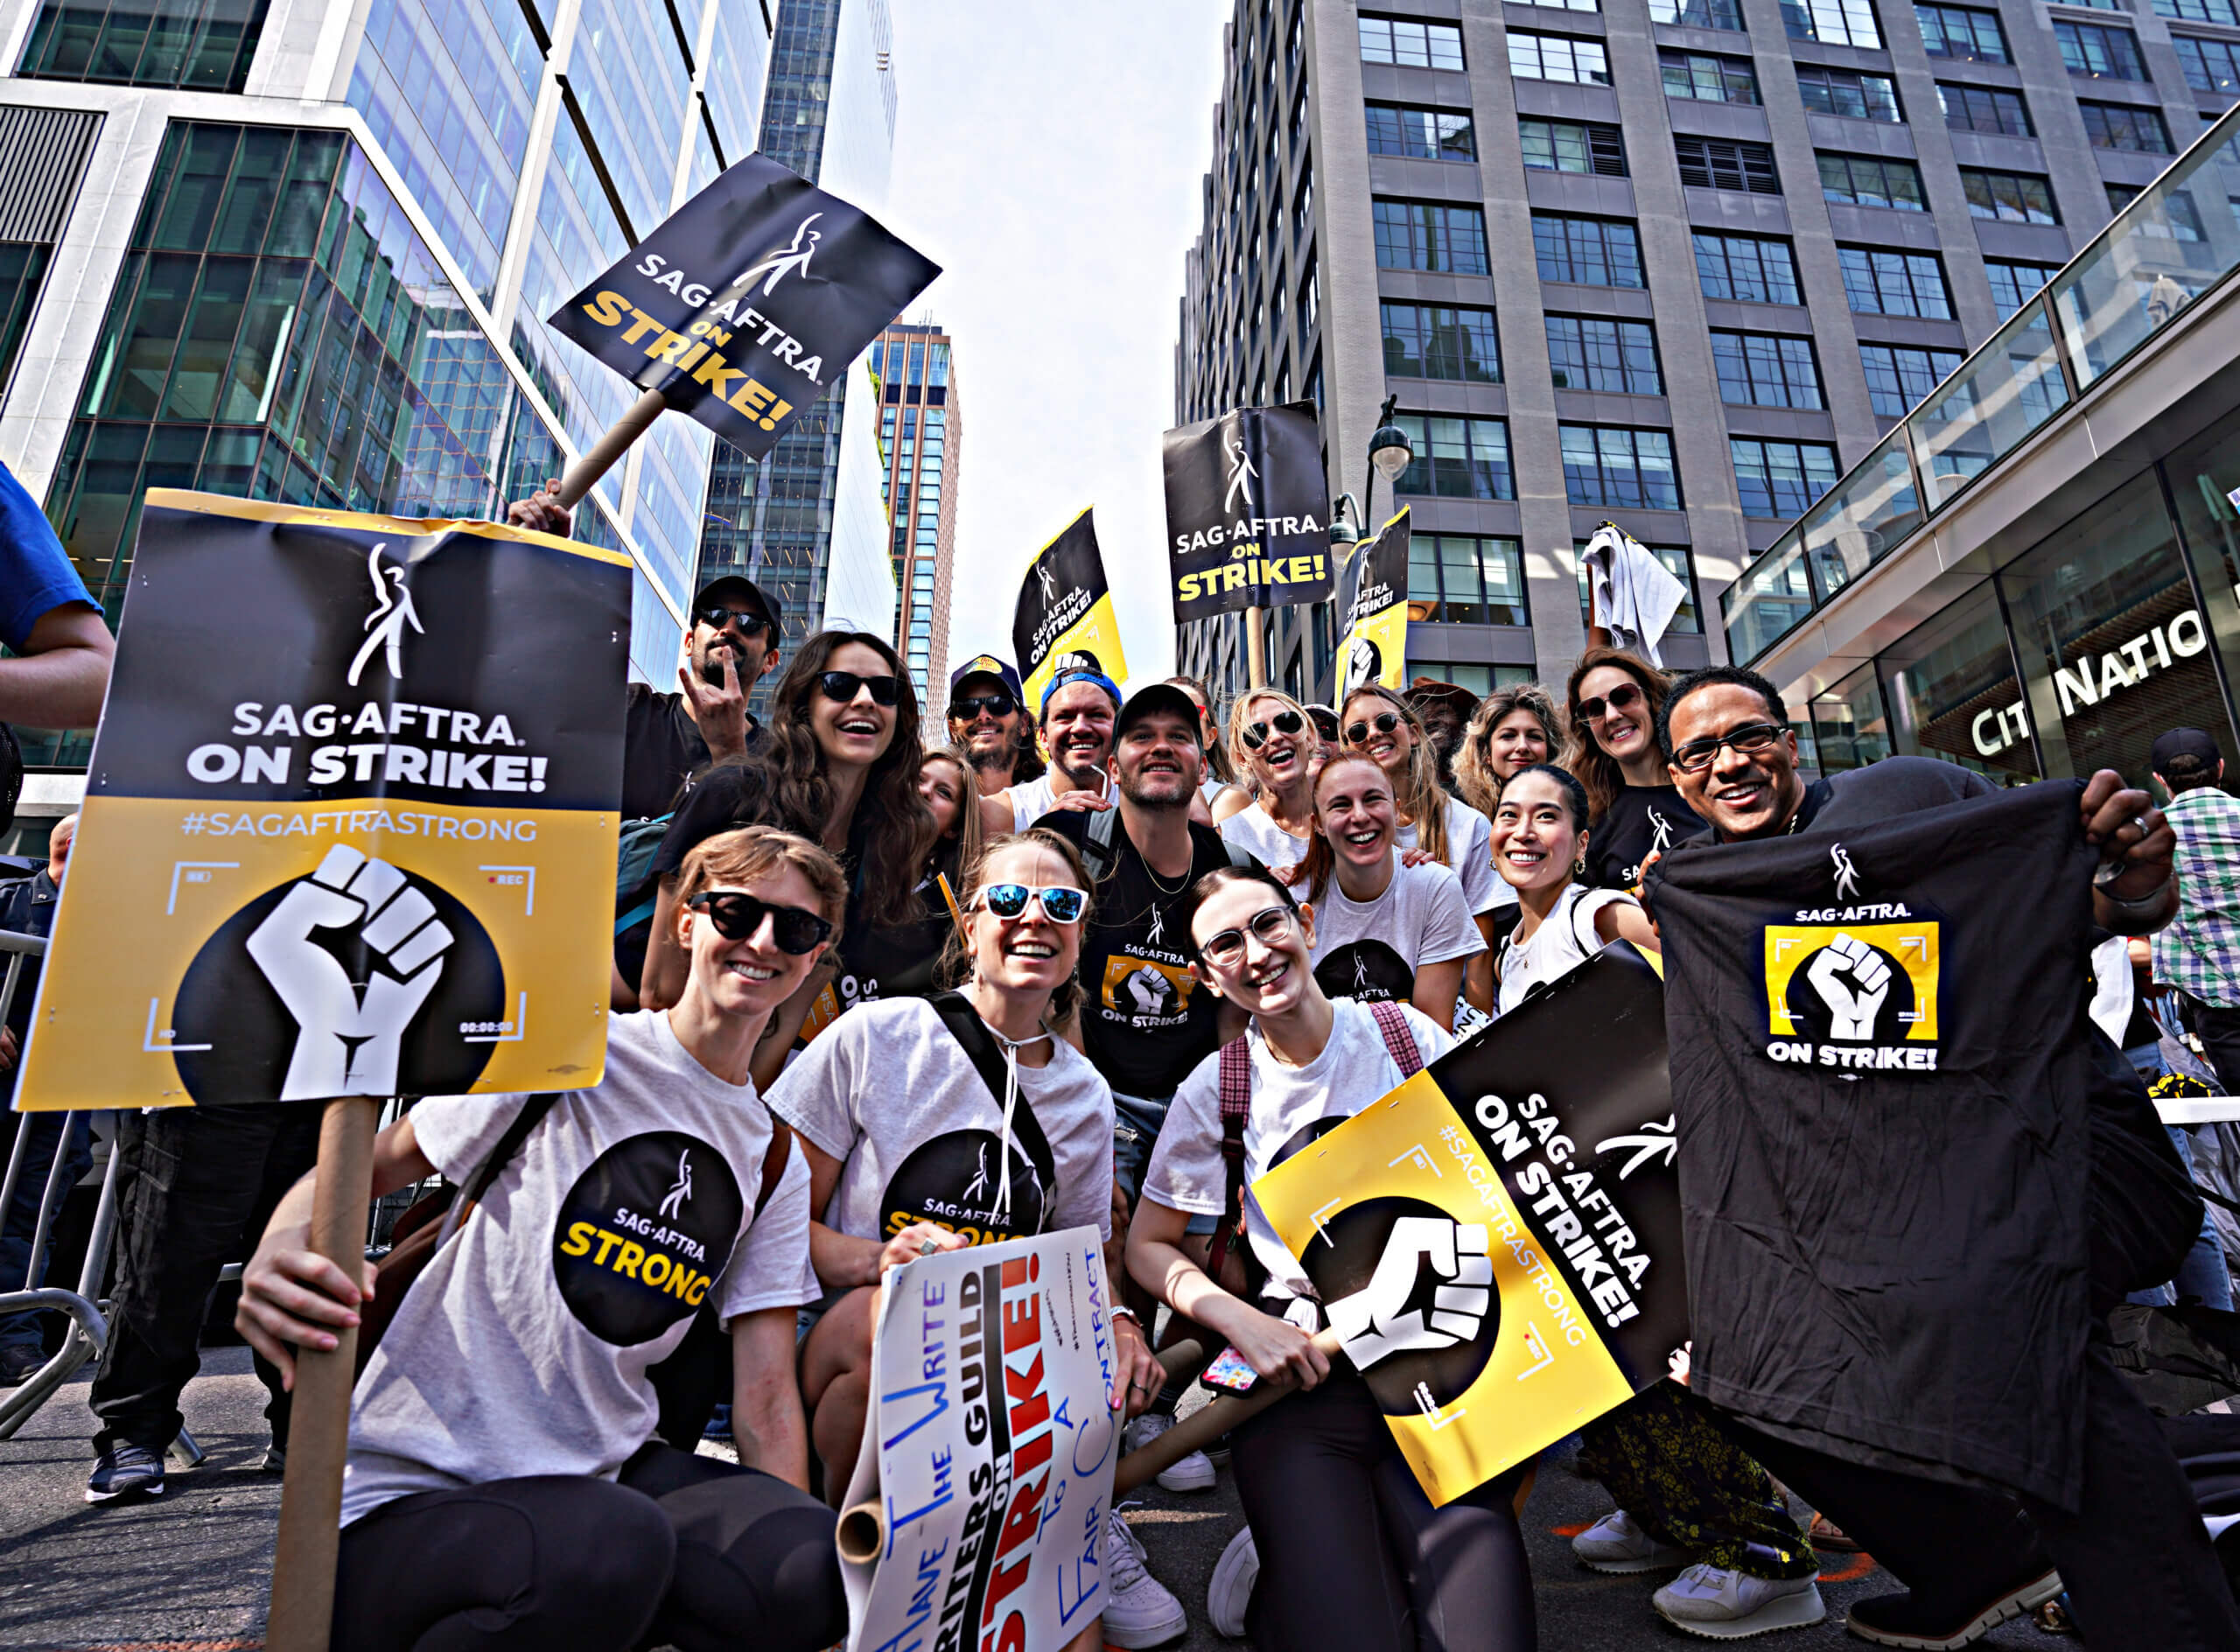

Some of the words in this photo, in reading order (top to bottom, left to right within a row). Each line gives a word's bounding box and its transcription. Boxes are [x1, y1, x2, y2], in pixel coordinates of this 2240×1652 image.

[582, 290, 794, 431] STRIKE!
[690, 321, 733, 348] ON
[1178, 555, 1326, 601] STRIKE!
[1232, 542, 1261, 559] ON
[1031, 641, 1047, 664] ON
[1046, 589, 1092, 645] STRIKE!
[1355, 590, 1394, 616] TRIKE!
[1971, 700, 2031, 757] CIT
[2054, 609, 2207, 717] NATIO
[186, 743, 291, 784] ON
[308, 744, 549, 793] STRIKE!
[181, 810, 537, 843] #SAGAFTRASTRONG
[497, 874, 524, 885] REC
[1102, 1009, 1127, 1022] ON
[1131, 1011, 1188, 1027] STRIKE!
[1767, 1041, 1813, 1064] ON
[1818, 1045, 1938, 1071] STRIKE!
[1438, 1125, 1587, 1347] #SAGAFTRASTRONG
[1475, 1095, 1532, 1162] ON
[1516, 1161, 1641, 1328] STRIKE!
[560, 1222, 711, 1306] STRONG
[960, 1271, 988, 1446] GUILD
[885, 1443, 954, 1561] THE
[992, 1452, 1012, 1512] ON
[1037, 1480, 1067, 1544] TO
[1054, 1396, 1074, 1429] A
[934, 1462, 994, 1652] RITERS
[1058, 1495, 1103, 1627] FAIR
